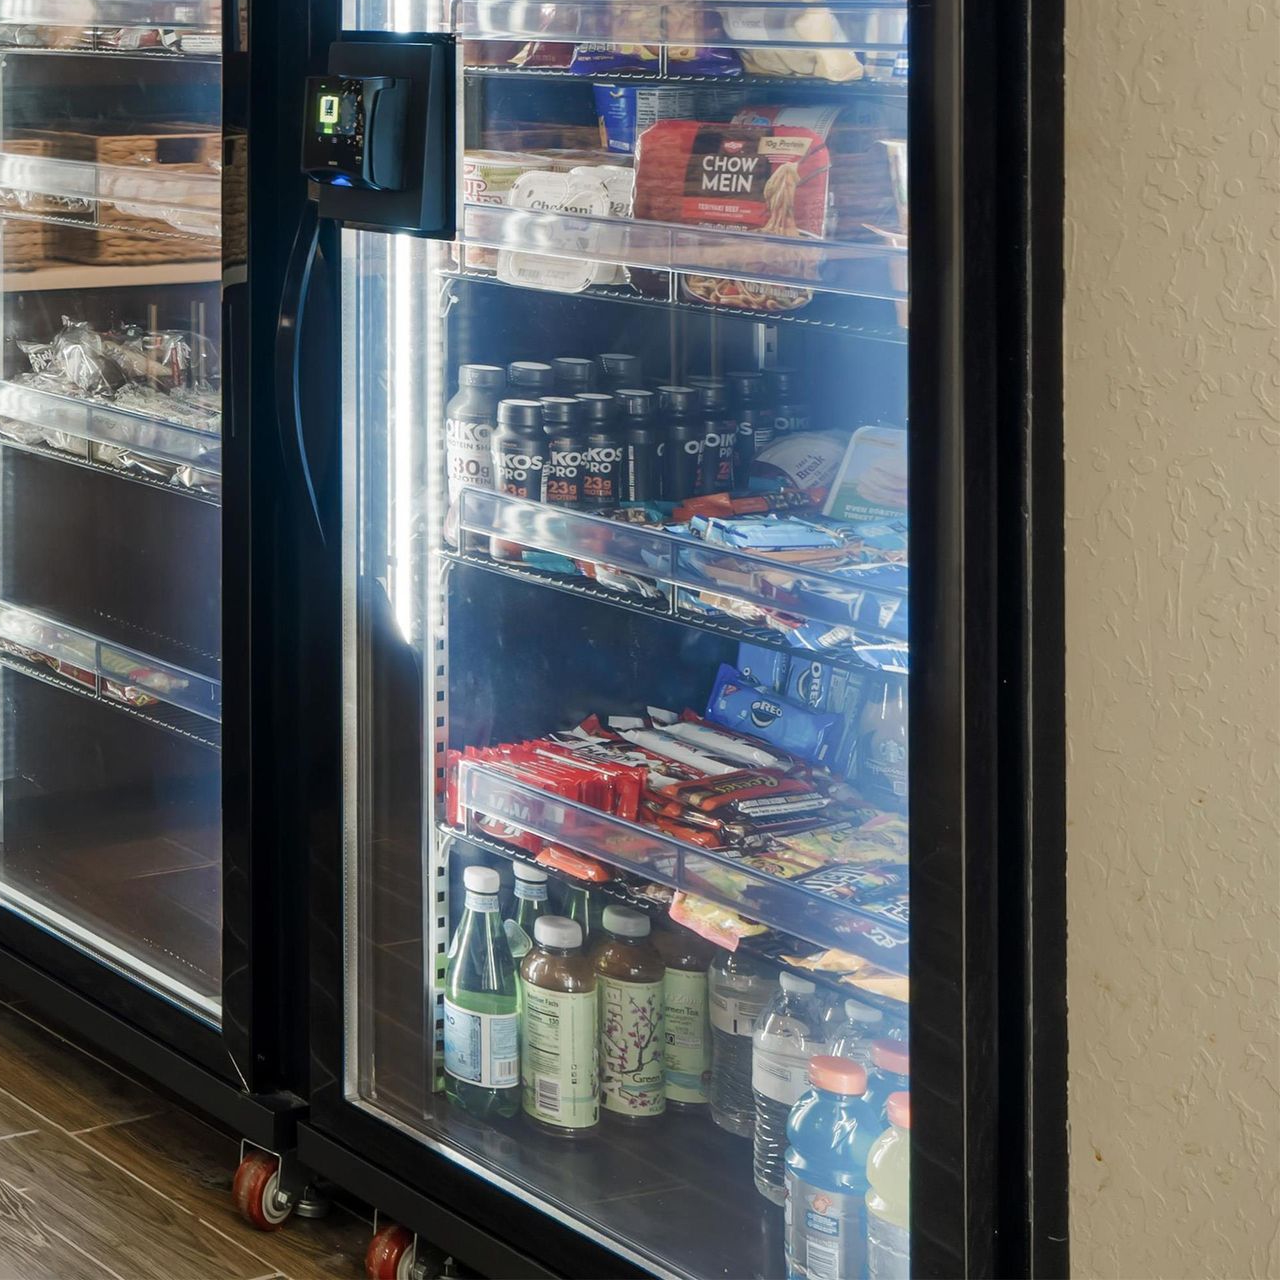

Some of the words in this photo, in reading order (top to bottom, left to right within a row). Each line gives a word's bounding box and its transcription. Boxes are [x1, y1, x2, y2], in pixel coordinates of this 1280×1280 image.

[778, 138, 806, 150] Protein
[702, 156, 759, 173] CHOW
[701, 173, 753, 193] MEIN
[453, 456, 490, 477] 30g
[499, 466, 527, 481] PRO
[548, 466, 577, 478] PRO
[795, 455, 825, 481] Break
[547, 480, 577, 495] 23g
[583, 475, 612, 490] 23g
[583, 489, 612, 497] PROTEIN
[751, 700, 784, 718] OREO
[686, 1007, 699, 1017] Tea
[632, 1072, 662, 1084] Green
